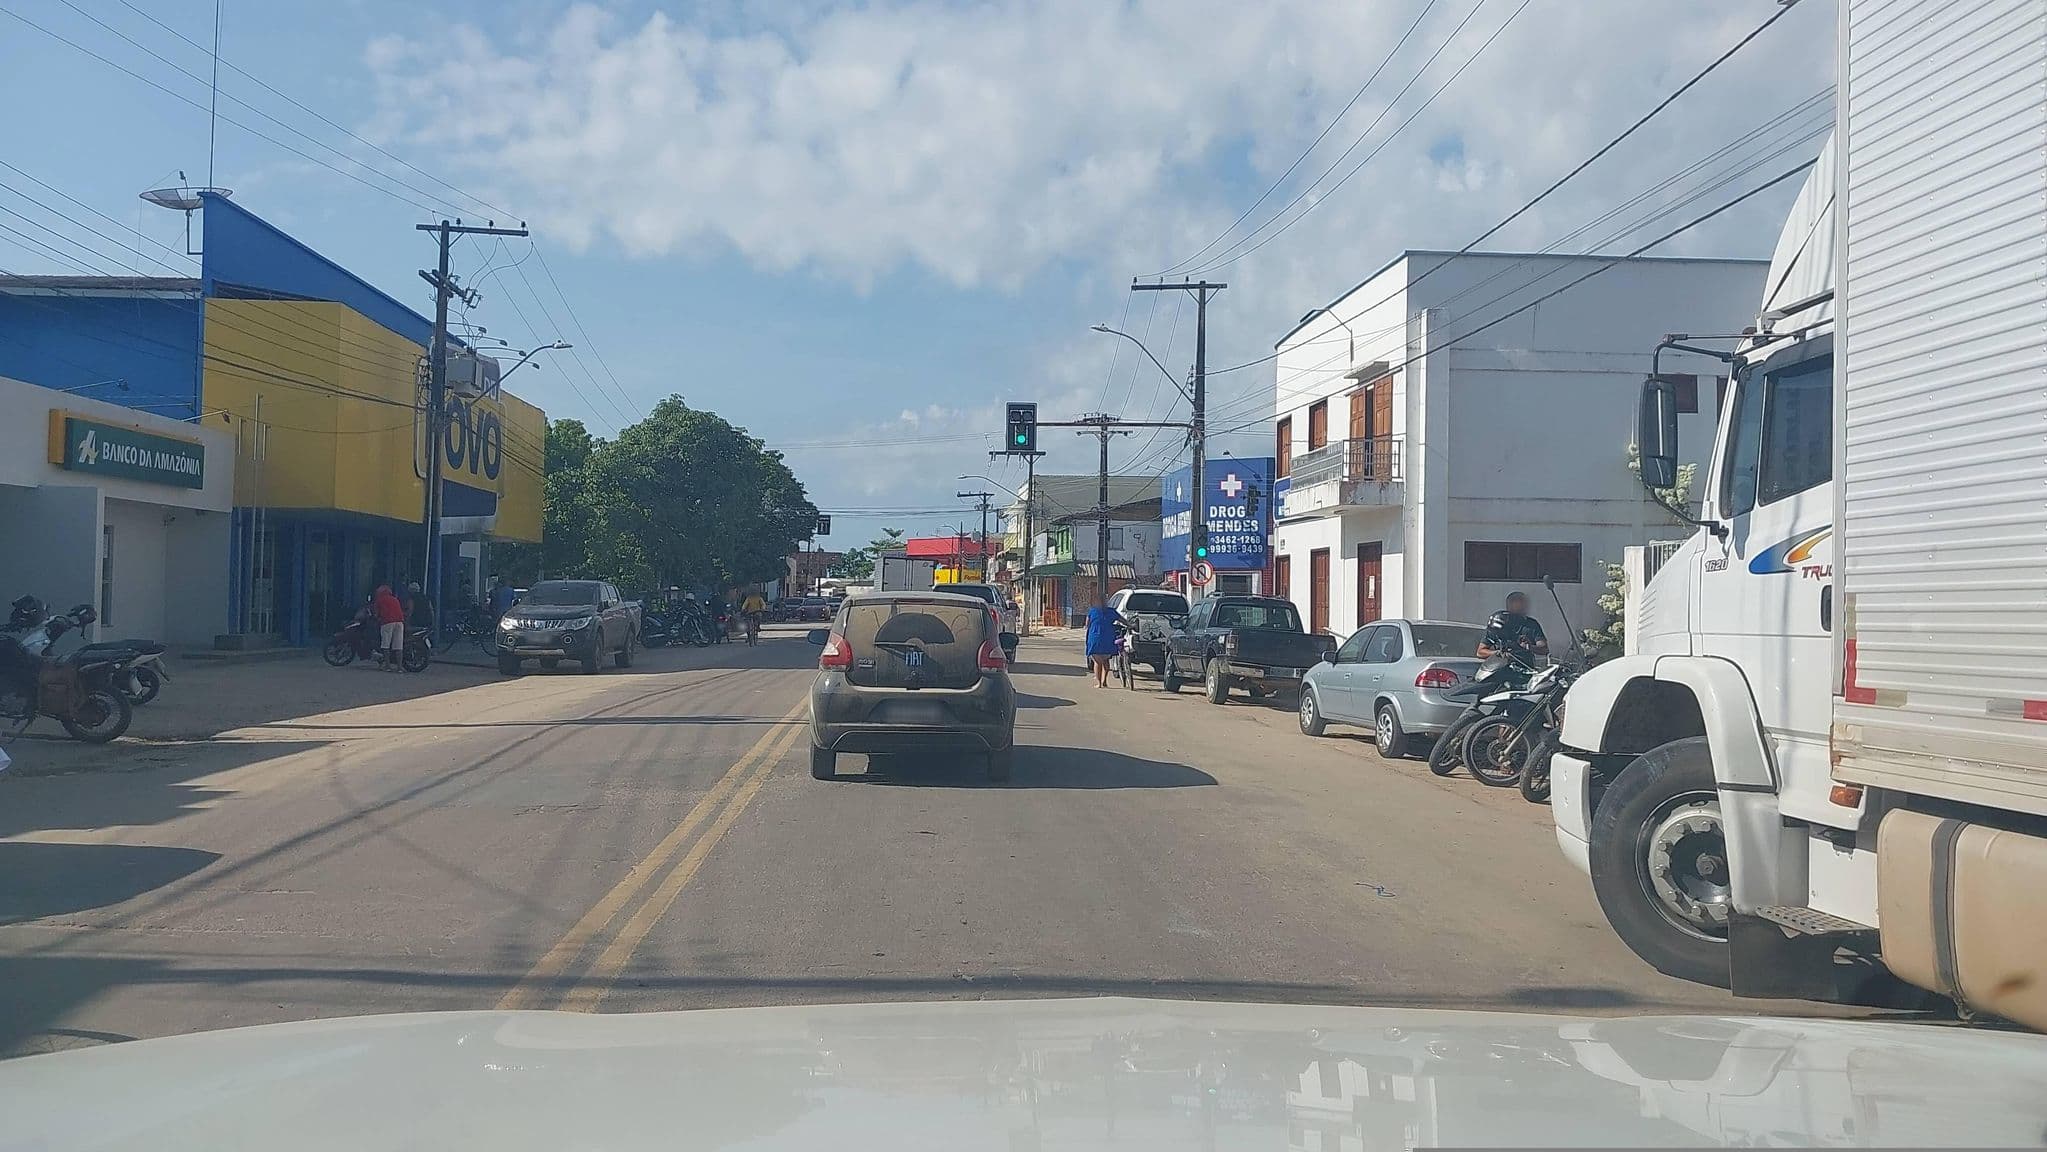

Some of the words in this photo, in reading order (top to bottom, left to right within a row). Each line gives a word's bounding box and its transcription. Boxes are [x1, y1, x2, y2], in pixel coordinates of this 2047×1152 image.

[102, 441, 138, 465] BANCO
[139, 450, 152, 467] DA
[153, 451, 201, 476] AMAZÔNIA
[1209, 505, 1246, 518] DROG
[1206, 519, 1259, 533] MENDES
[1704, 559, 1729, 572] 1620
[905, 651, 924, 667] FIAT
